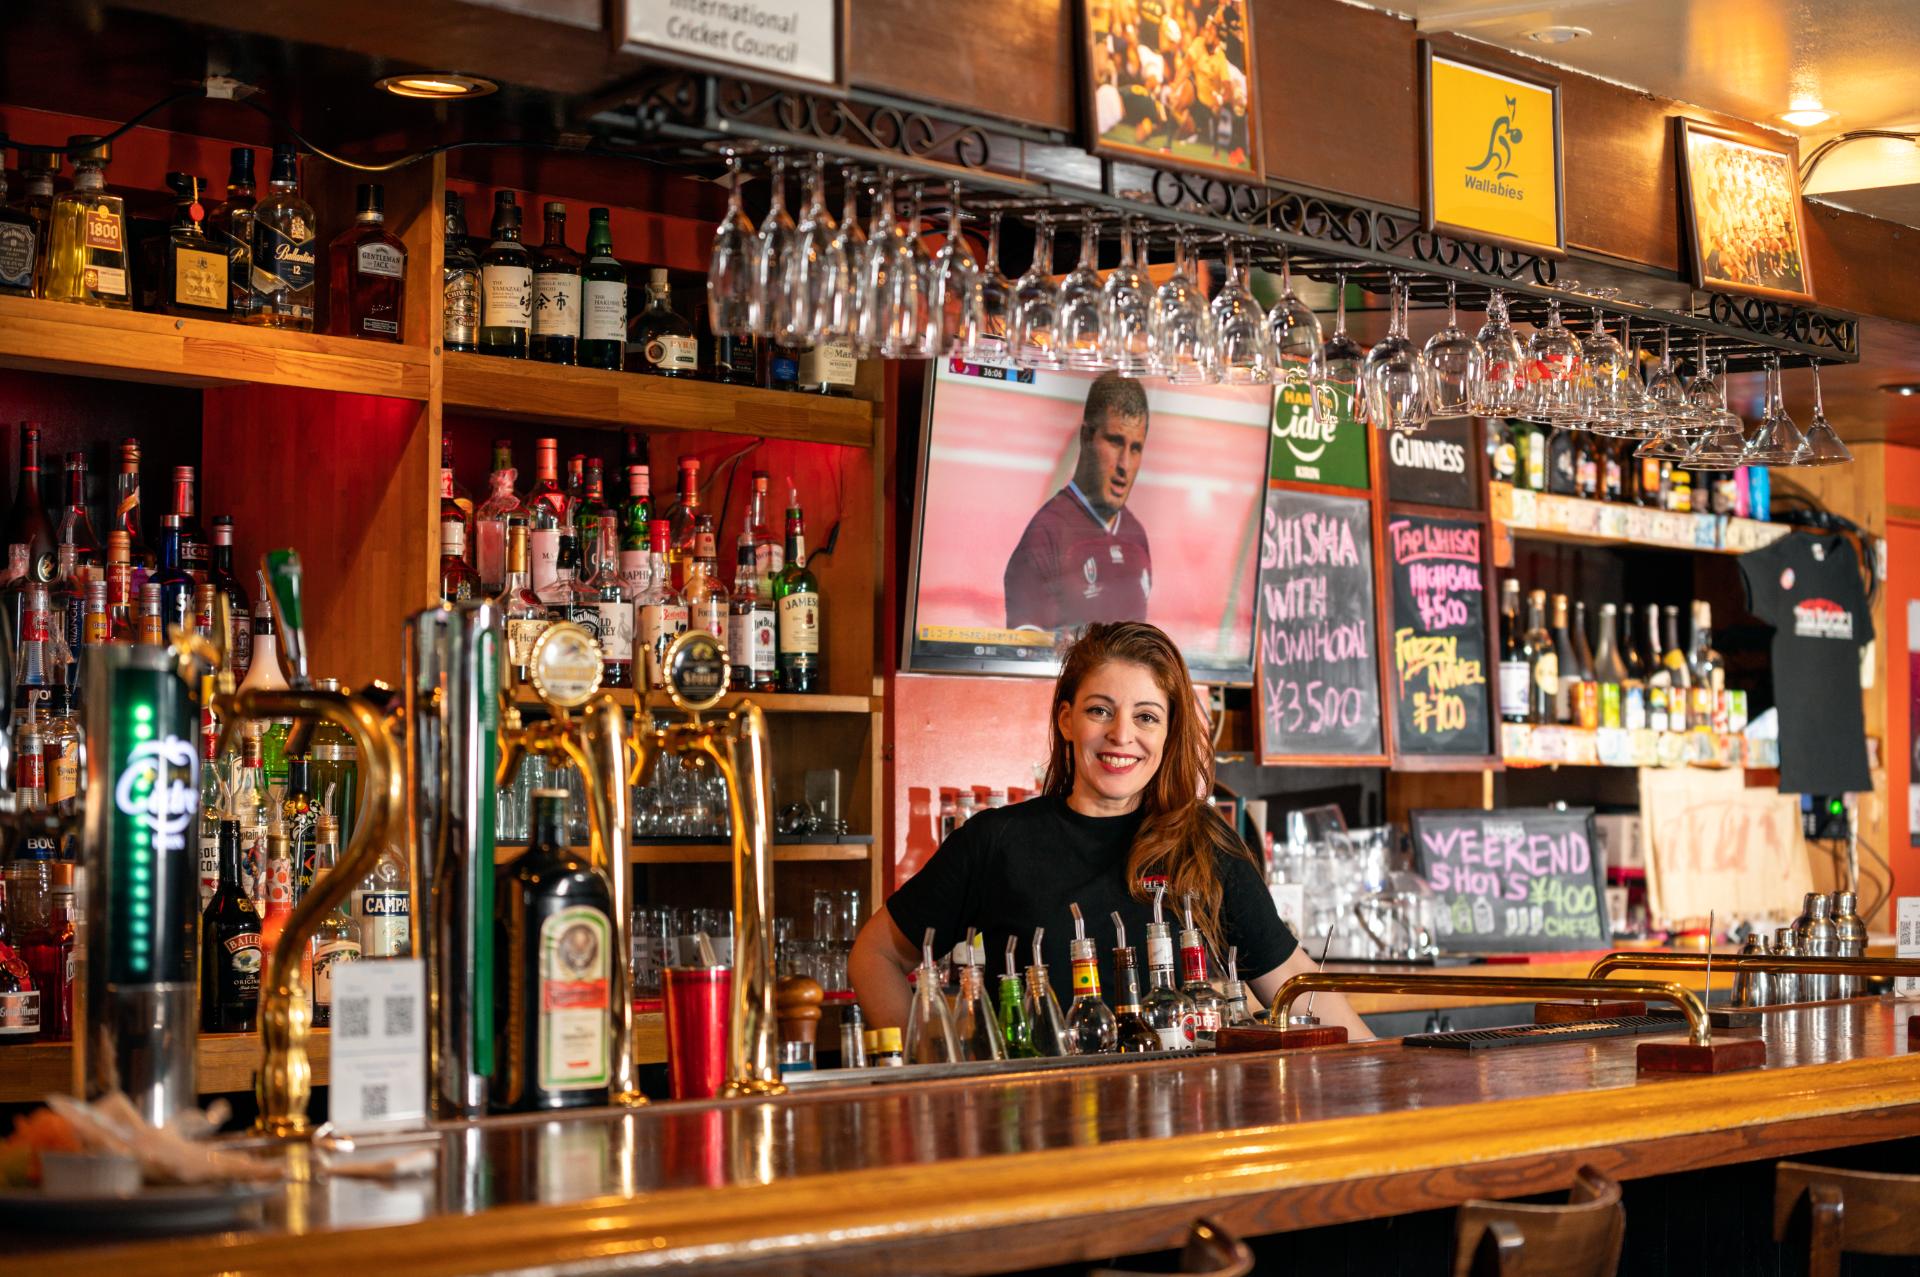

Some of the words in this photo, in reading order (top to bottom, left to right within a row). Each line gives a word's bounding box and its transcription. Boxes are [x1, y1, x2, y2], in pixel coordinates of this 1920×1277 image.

[666, 15, 729, 49] Cricket
[731, 30, 798, 63] Council
[1464, 174, 1524, 201] Wallabies
[89, 222, 119, 239] 1800
[362, 251, 400, 264] GENTLEMAN
[373, 260, 389, 269] JACK
[293, 266, 301, 275] 12
[447, 290, 470, 299] CHIVAS
[535, 291, 570, 311] 余市
[983, 367, 1003, 378] 36:06
[1390, 431, 1465, 474] GUINNESS
[1261, 506, 1360, 570] SHISHA
[1264, 575, 1328, 622] WITH
[1421, 827, 1592, 877] WEEKEND
[1430, 862, 1530, 901] SHOTS
